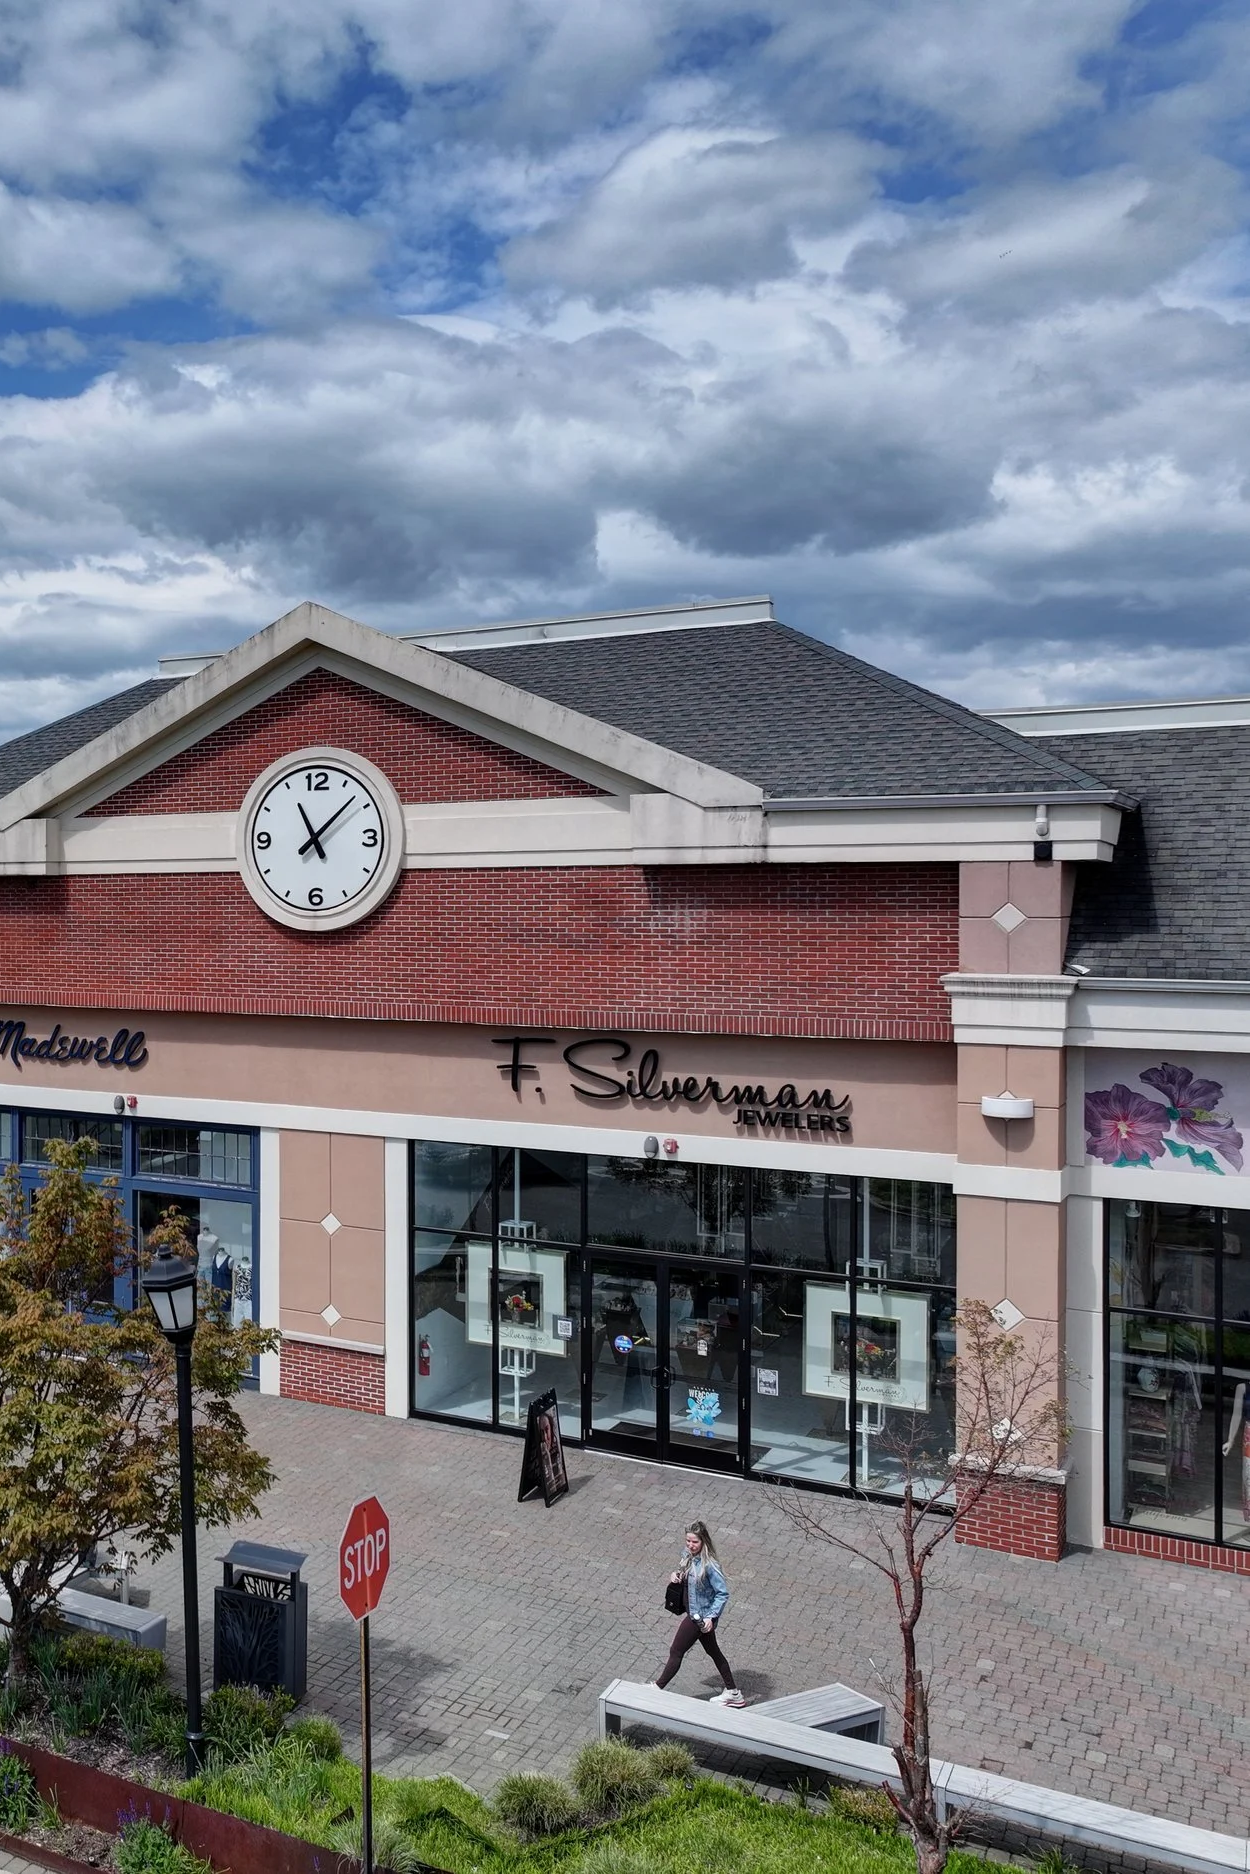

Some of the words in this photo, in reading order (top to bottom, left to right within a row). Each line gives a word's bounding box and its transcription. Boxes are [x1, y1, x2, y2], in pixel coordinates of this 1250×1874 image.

[305, 772, 330, 791] 12
[256, 831, 272, 850] 9
[362, 828, 378, 848] 3
[307, 887, 324, 906] 6
[491, 1036, 556, 1093] F.
[563, 1038, 850, 1112] Silverman
[733, 1108, 850, 1133] JEWELERS
[344, 1527, 387, 1590] STOP
